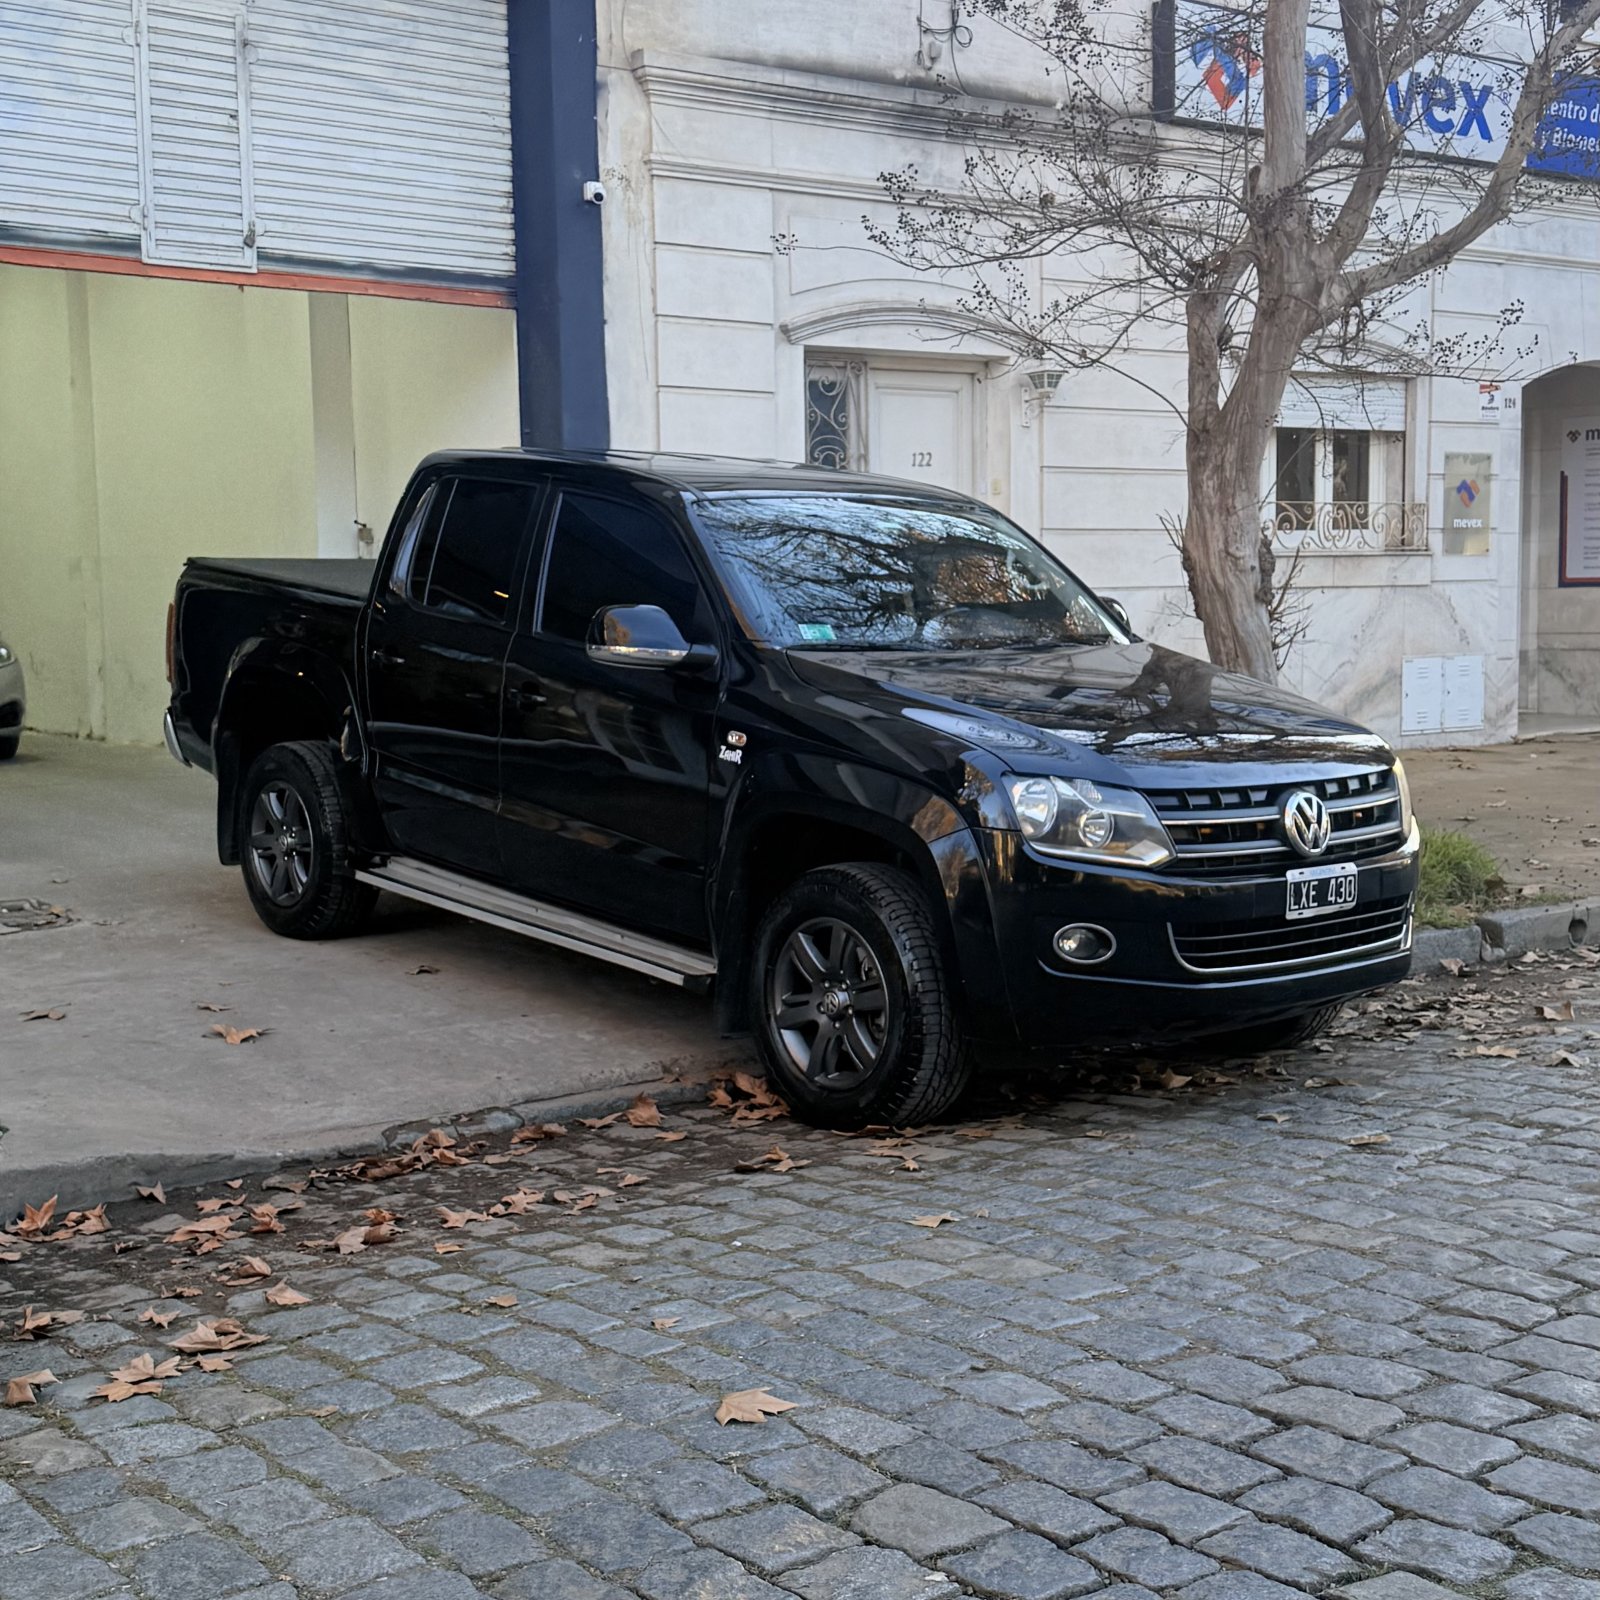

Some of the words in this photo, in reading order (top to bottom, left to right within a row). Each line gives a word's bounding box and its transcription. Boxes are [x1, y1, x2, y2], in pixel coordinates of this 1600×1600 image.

[1304, 51, 1494, 142] mvex
[1543, 100, 1588, 121] entro
[911, 452, 932, 467] 122
[1453, 519, 1482, 528] mevex
[1290, 881, 1318, 910] LXE
[1327, 876, 1355, 904] 430
